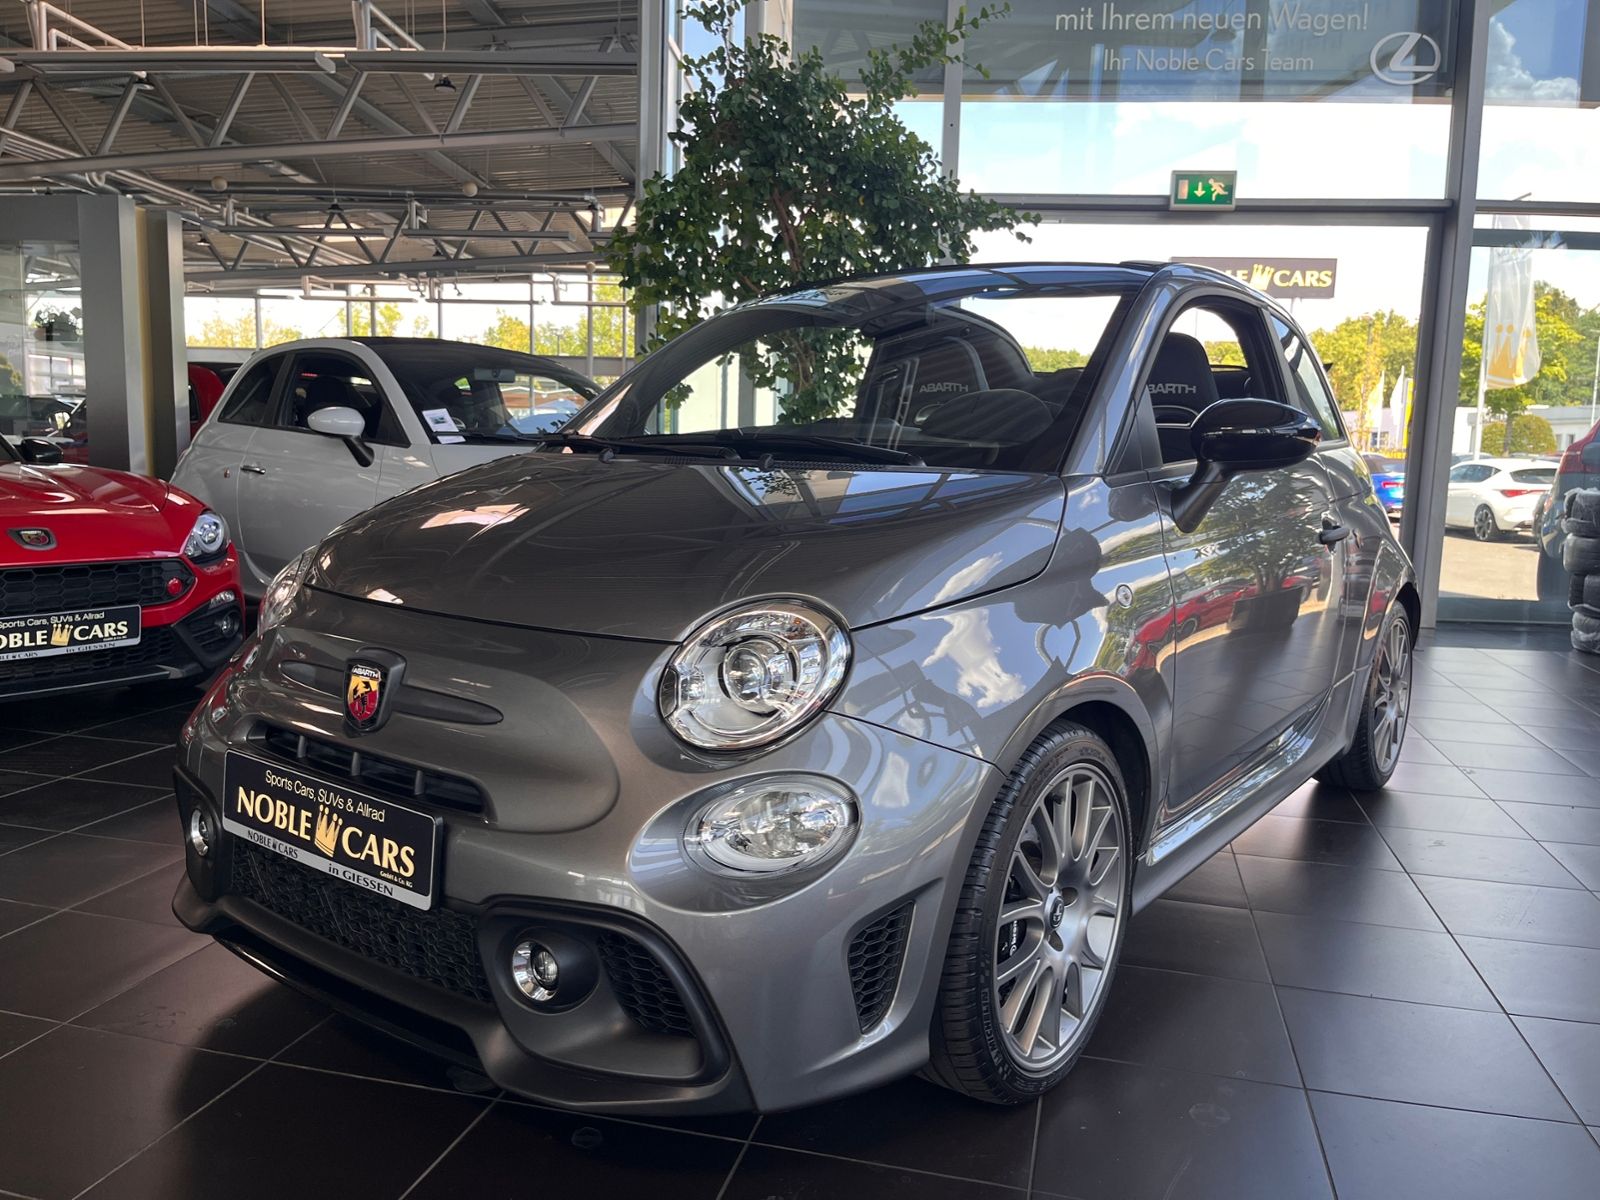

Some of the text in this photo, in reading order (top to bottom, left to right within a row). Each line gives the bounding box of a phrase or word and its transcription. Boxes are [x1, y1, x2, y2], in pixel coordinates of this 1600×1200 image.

[1055, 1, 1369, 37] mit Ihrem neuen Wagen!
[1103, 48, 1314, 71] Ihr Noble Cars Team
[1273, 270, 1333, 287] CARS
[919, 382, 969, 393] ABARTH
[1148, 383, 1197, 394] BARTH
[27, 618, 49, 627] Cars,
[50, 615, 73, 624] SUVs
[75, 613, 81, 622] &
[82, 611, 105, 620] Allrad
[73, 620, 128, 641] CARS
[352, 667, 378, 678] ABARTH
[265, 769, 386, 823] Sports Cars, SUVs & Allrad
[237, 786, 415, 878] NOBLE CARS
[247, 829, 299, 859] NOBLE CARS
[328, 863, 394, 897] in GIESSEN
